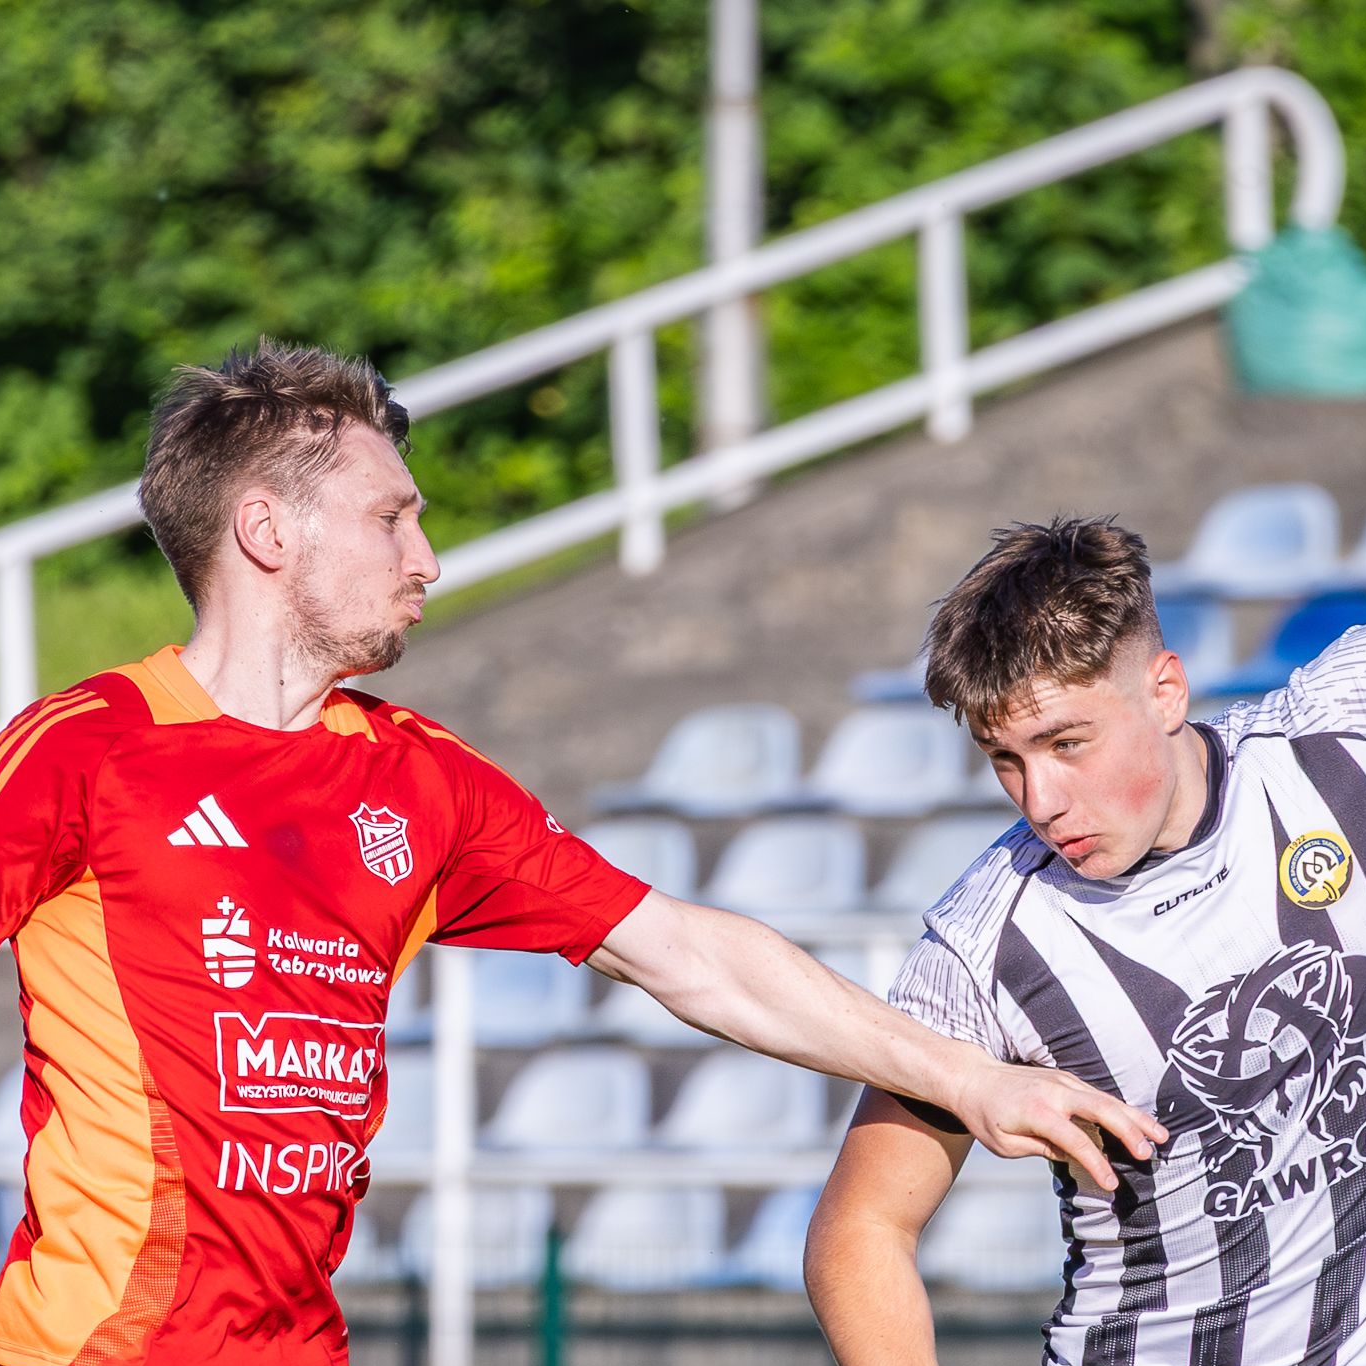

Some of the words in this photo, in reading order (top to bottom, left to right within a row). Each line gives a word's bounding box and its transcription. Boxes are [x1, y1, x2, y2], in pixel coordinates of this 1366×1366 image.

[1289, 835, 1306, 850] 1922
[267, 928, 359, 957] Kalwaria
[236, 1085, 297, 1099] WSZYSTKO
[298, 1086, 318, 1098] DO
